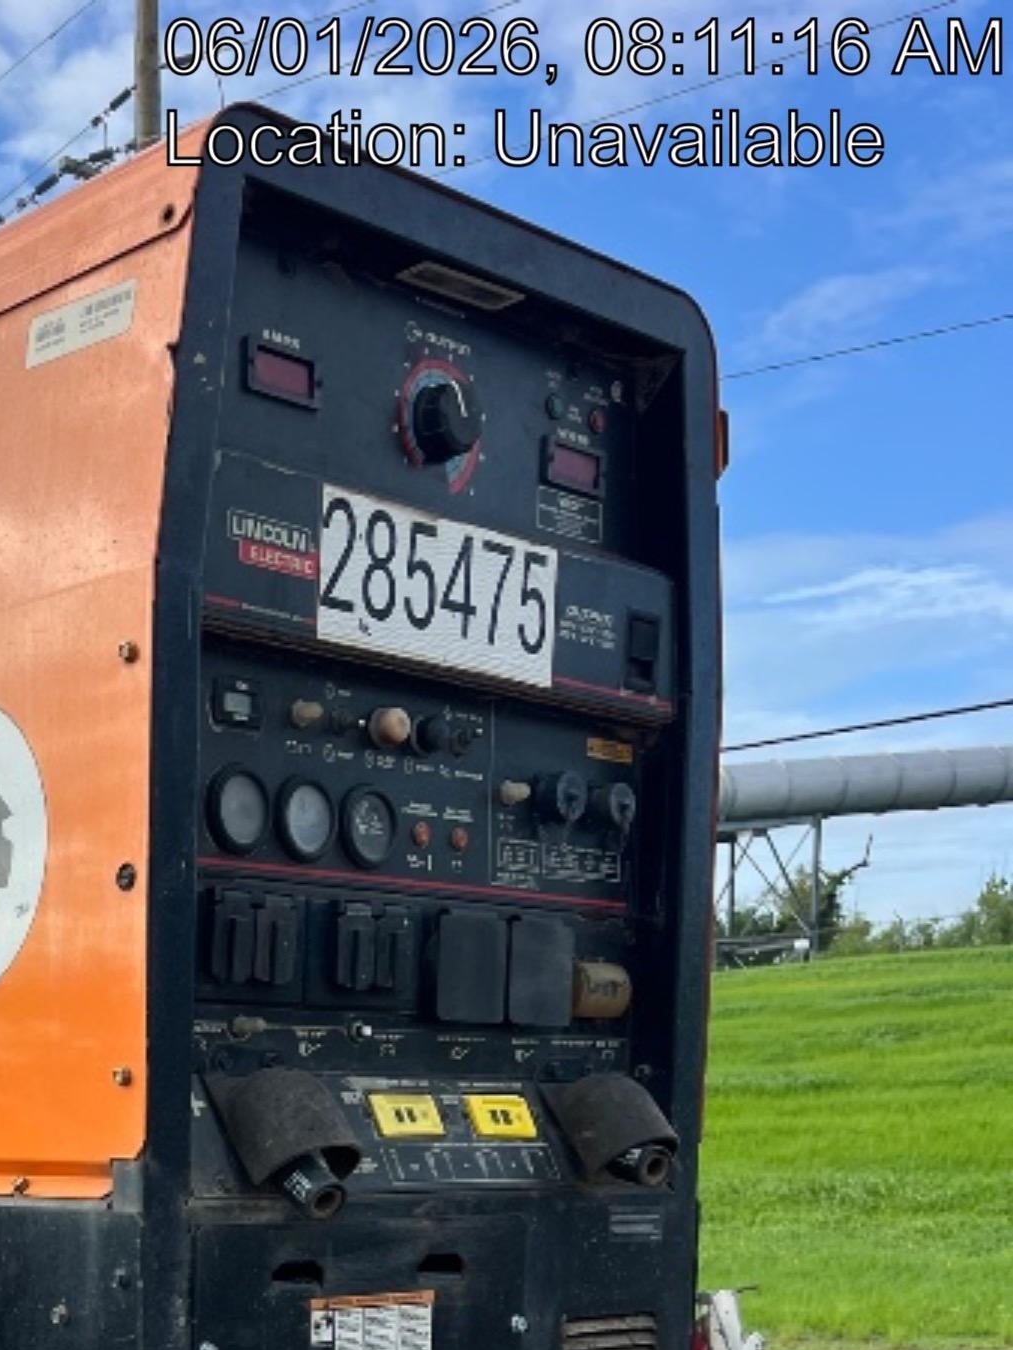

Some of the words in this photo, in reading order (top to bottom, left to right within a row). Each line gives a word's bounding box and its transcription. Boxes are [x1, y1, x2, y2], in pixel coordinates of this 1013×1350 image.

[231, 514, 307, 552] LINCOLN
[250, 545, 314, 574] ELECTRIC
[319, 497, 548, 655] 285475
